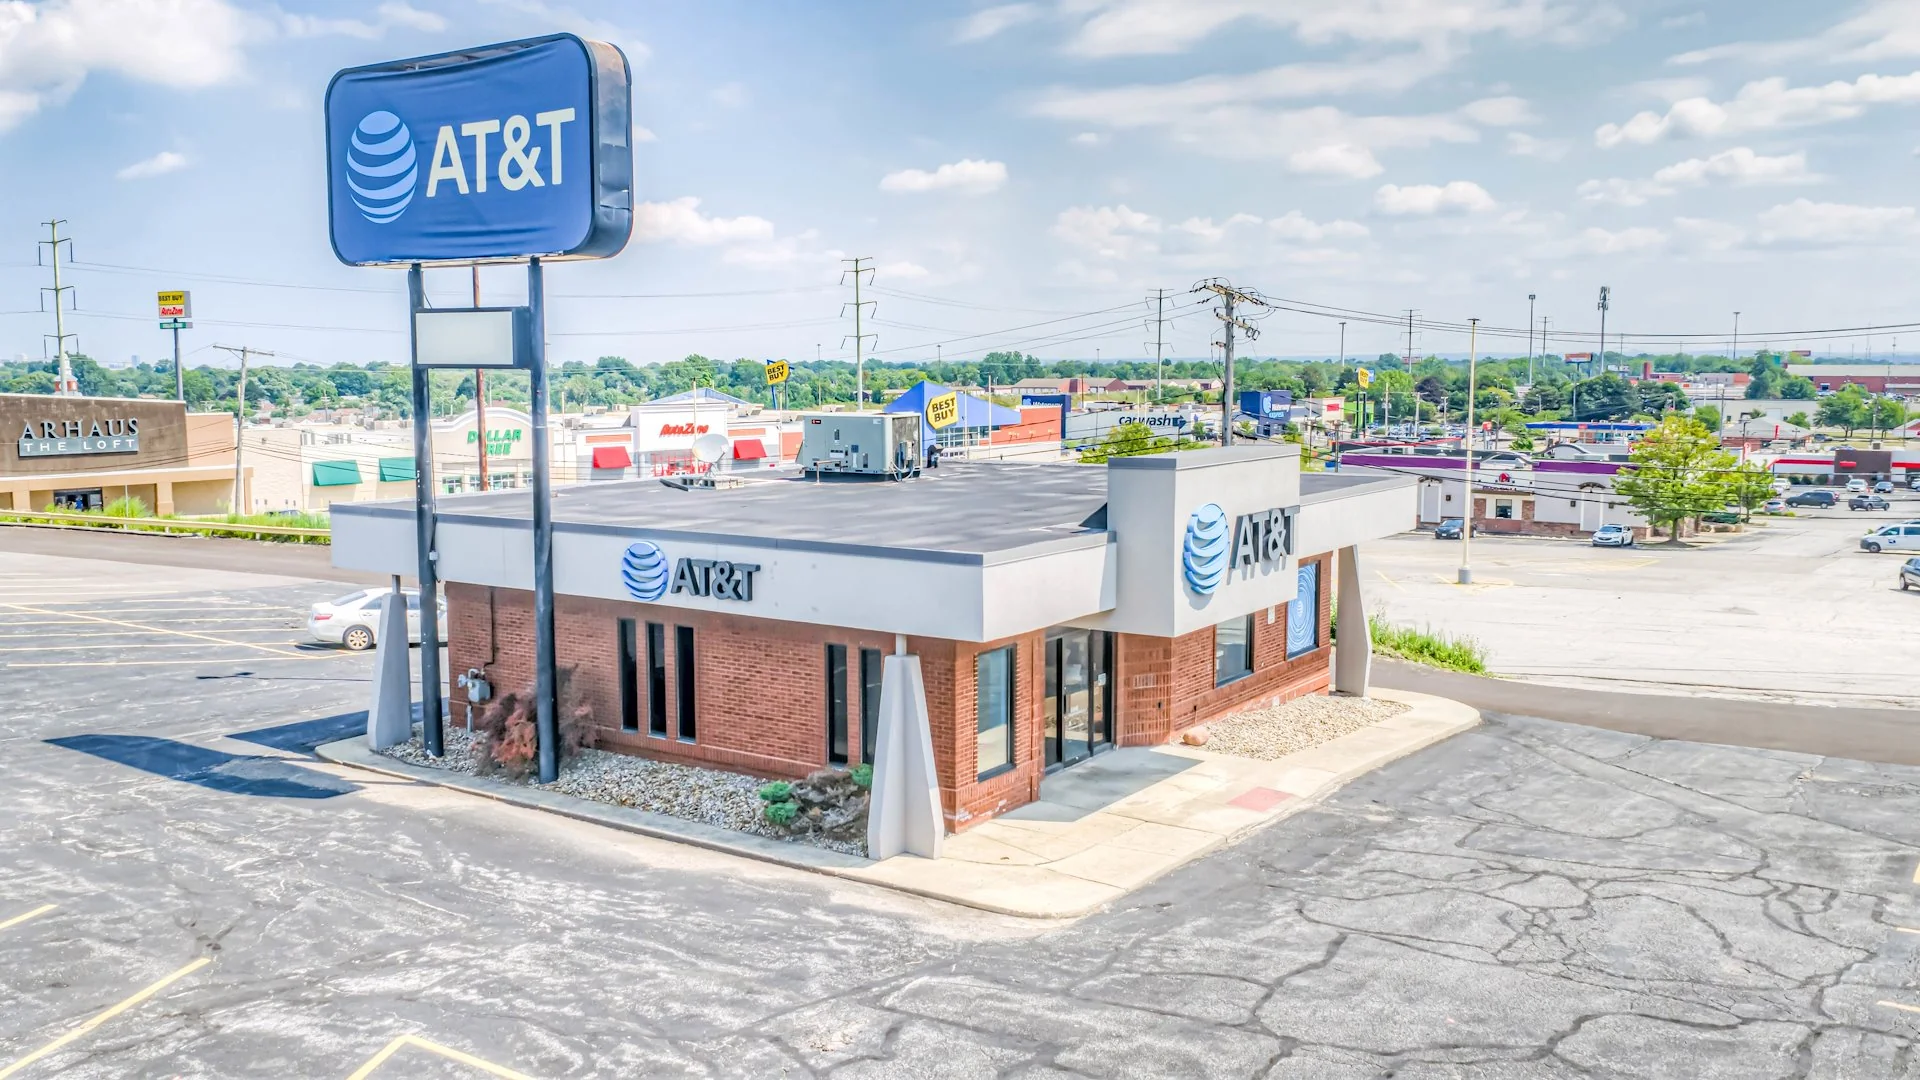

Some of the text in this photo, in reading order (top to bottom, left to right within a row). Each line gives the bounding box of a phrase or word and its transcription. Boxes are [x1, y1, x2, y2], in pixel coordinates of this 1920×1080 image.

[426, 107, 575, 198] AT&T
[767, 364, 785, 375] BEST
[769, 371, 784, 381] BUY
[932, 397, 955, 413] BEST
[934, 408, 955, 422] BUY
[1138, 414, 1171, 426] wash
[20, 418, 139, 439] ARHAUS
[467, 429, 522, 444] DLLAR
[24, 440, 135, 452] THE LOFT
[1230, 505, 1300, 569] AT&T
[670, 557, 761, 602] AT&T
